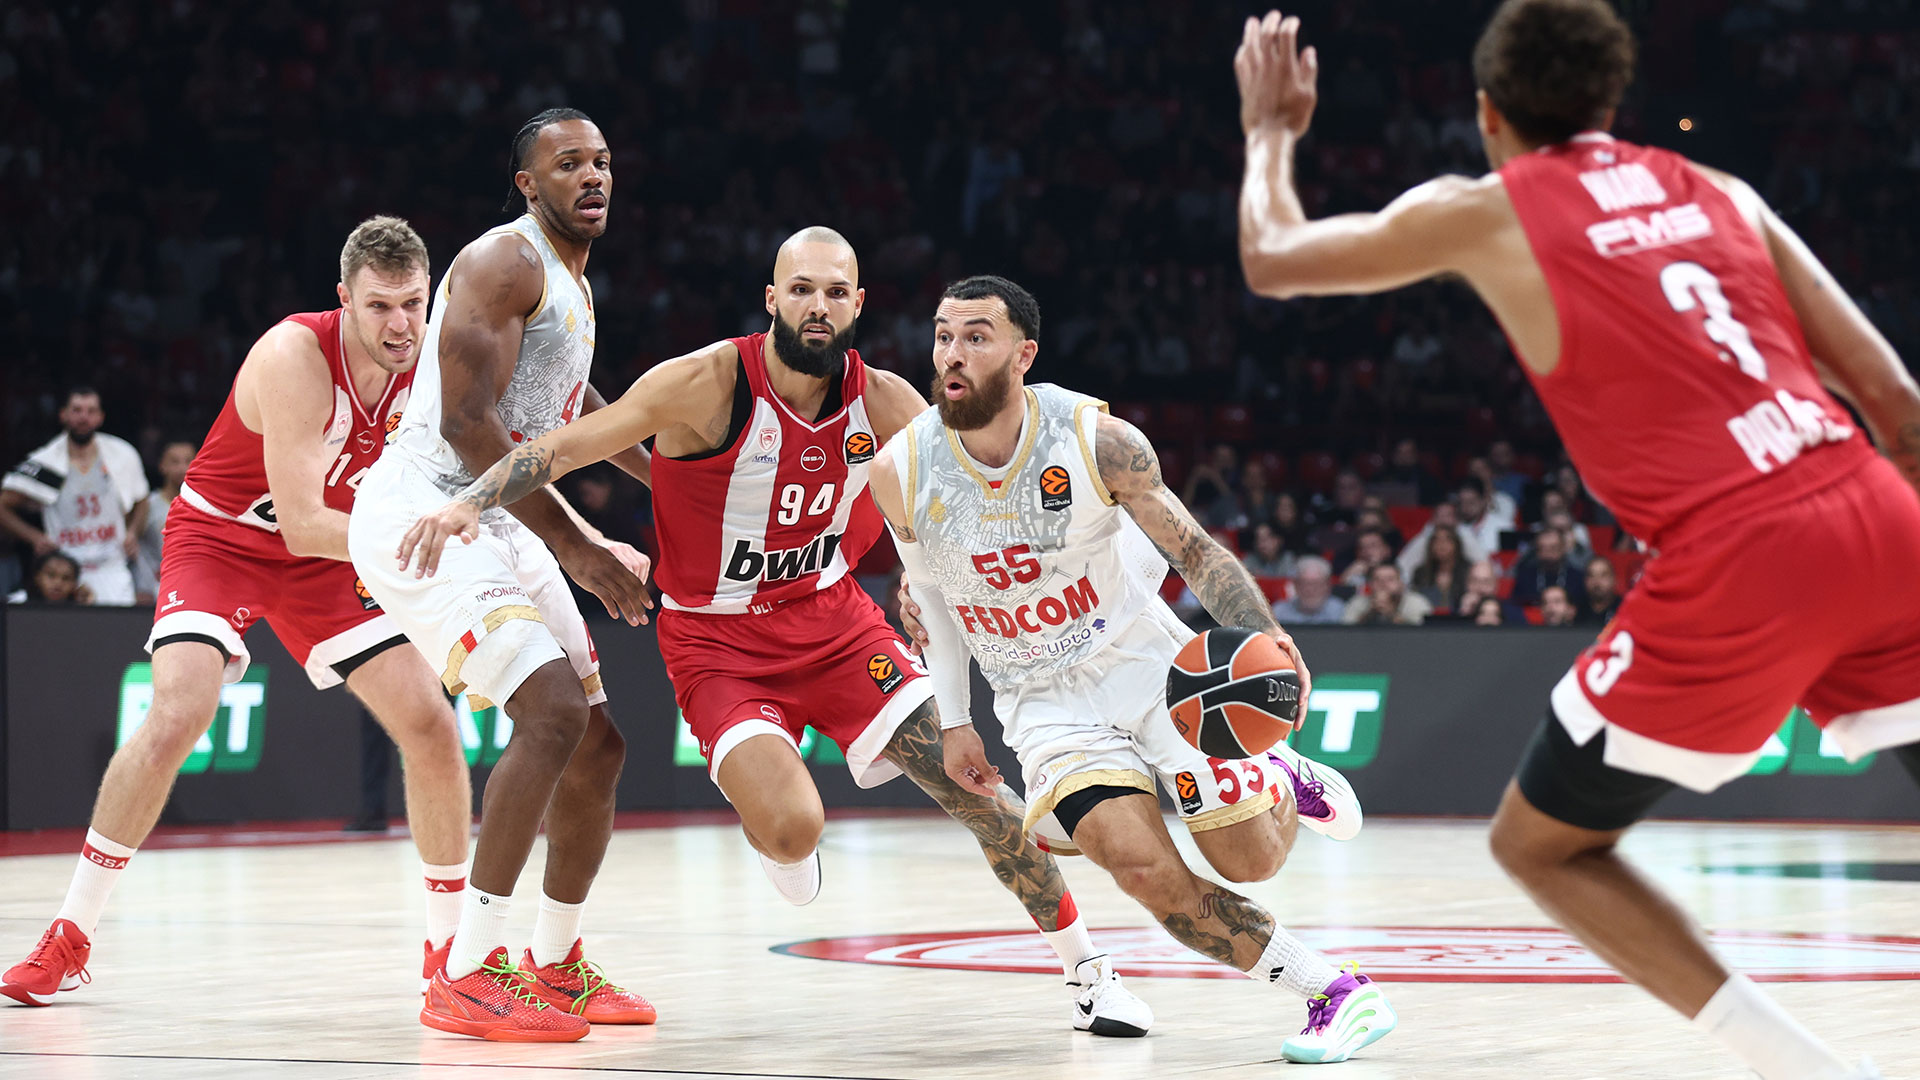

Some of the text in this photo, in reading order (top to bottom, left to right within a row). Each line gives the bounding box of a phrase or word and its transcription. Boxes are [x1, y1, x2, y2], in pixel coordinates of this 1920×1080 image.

[1660, 260, 1768, 381] 3
[777, 483, 836, 526] 94
[971, 544, 1041, 590] 55
[956, 575, 1100, 638] FEDCOM
[1585, 631, 1633, 696] 3
[1207, 757, 1264, 805] 55
[90, 851, 126, 868] GSA
